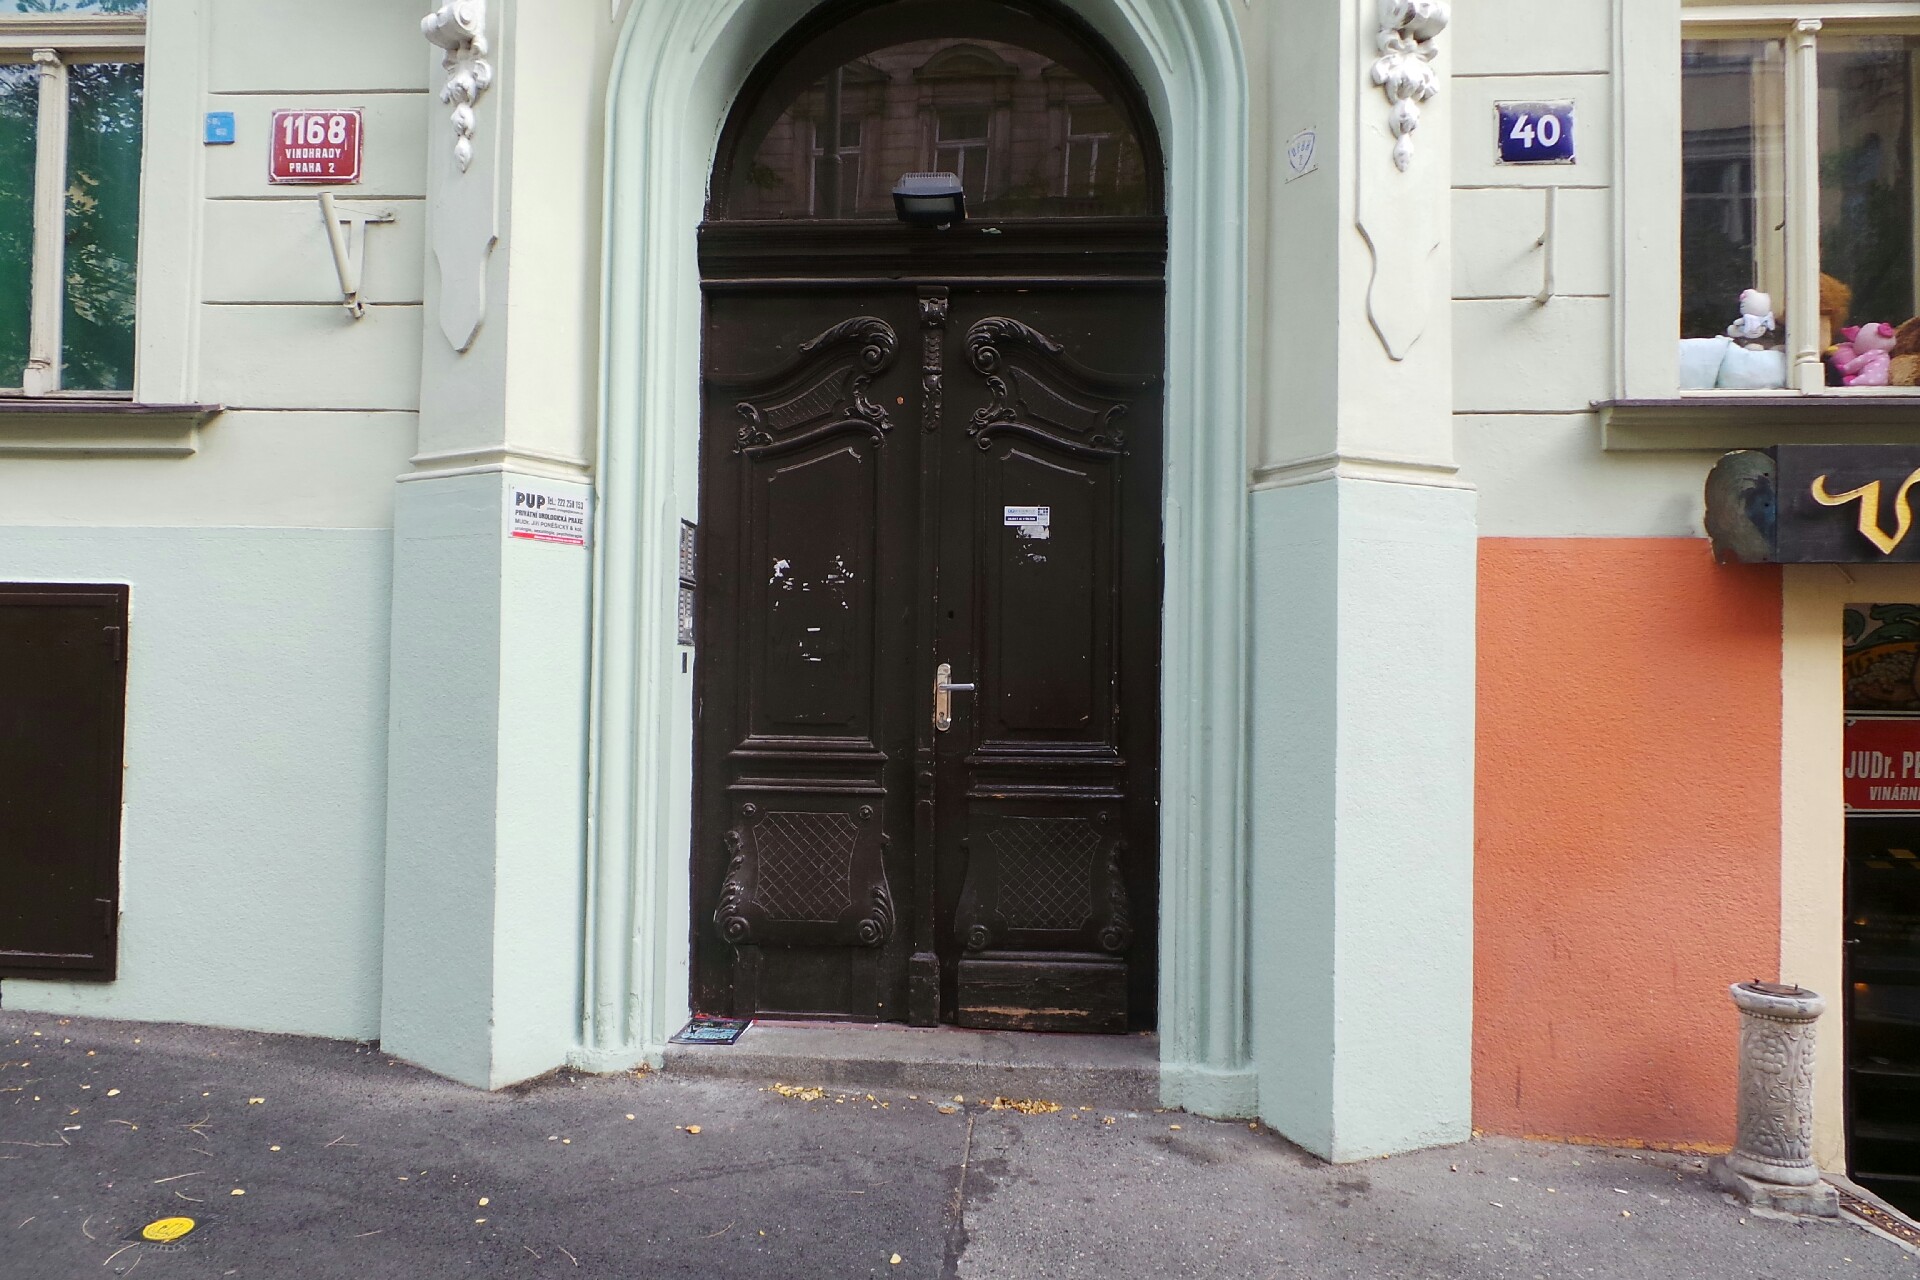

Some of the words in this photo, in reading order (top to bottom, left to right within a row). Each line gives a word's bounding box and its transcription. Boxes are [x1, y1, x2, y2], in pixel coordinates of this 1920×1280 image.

[283, 115, 346, 145] 1168
[1510, 114, 1560, 148] 40
[285, 148, 341, 159] VINOHRADY
[289, 162, 322, 173] PRAHA
[328, 162, 335, 173] 2
[516, 492, 545, 509] PUP
[1844, 751, 1895, 778] JUDr.
